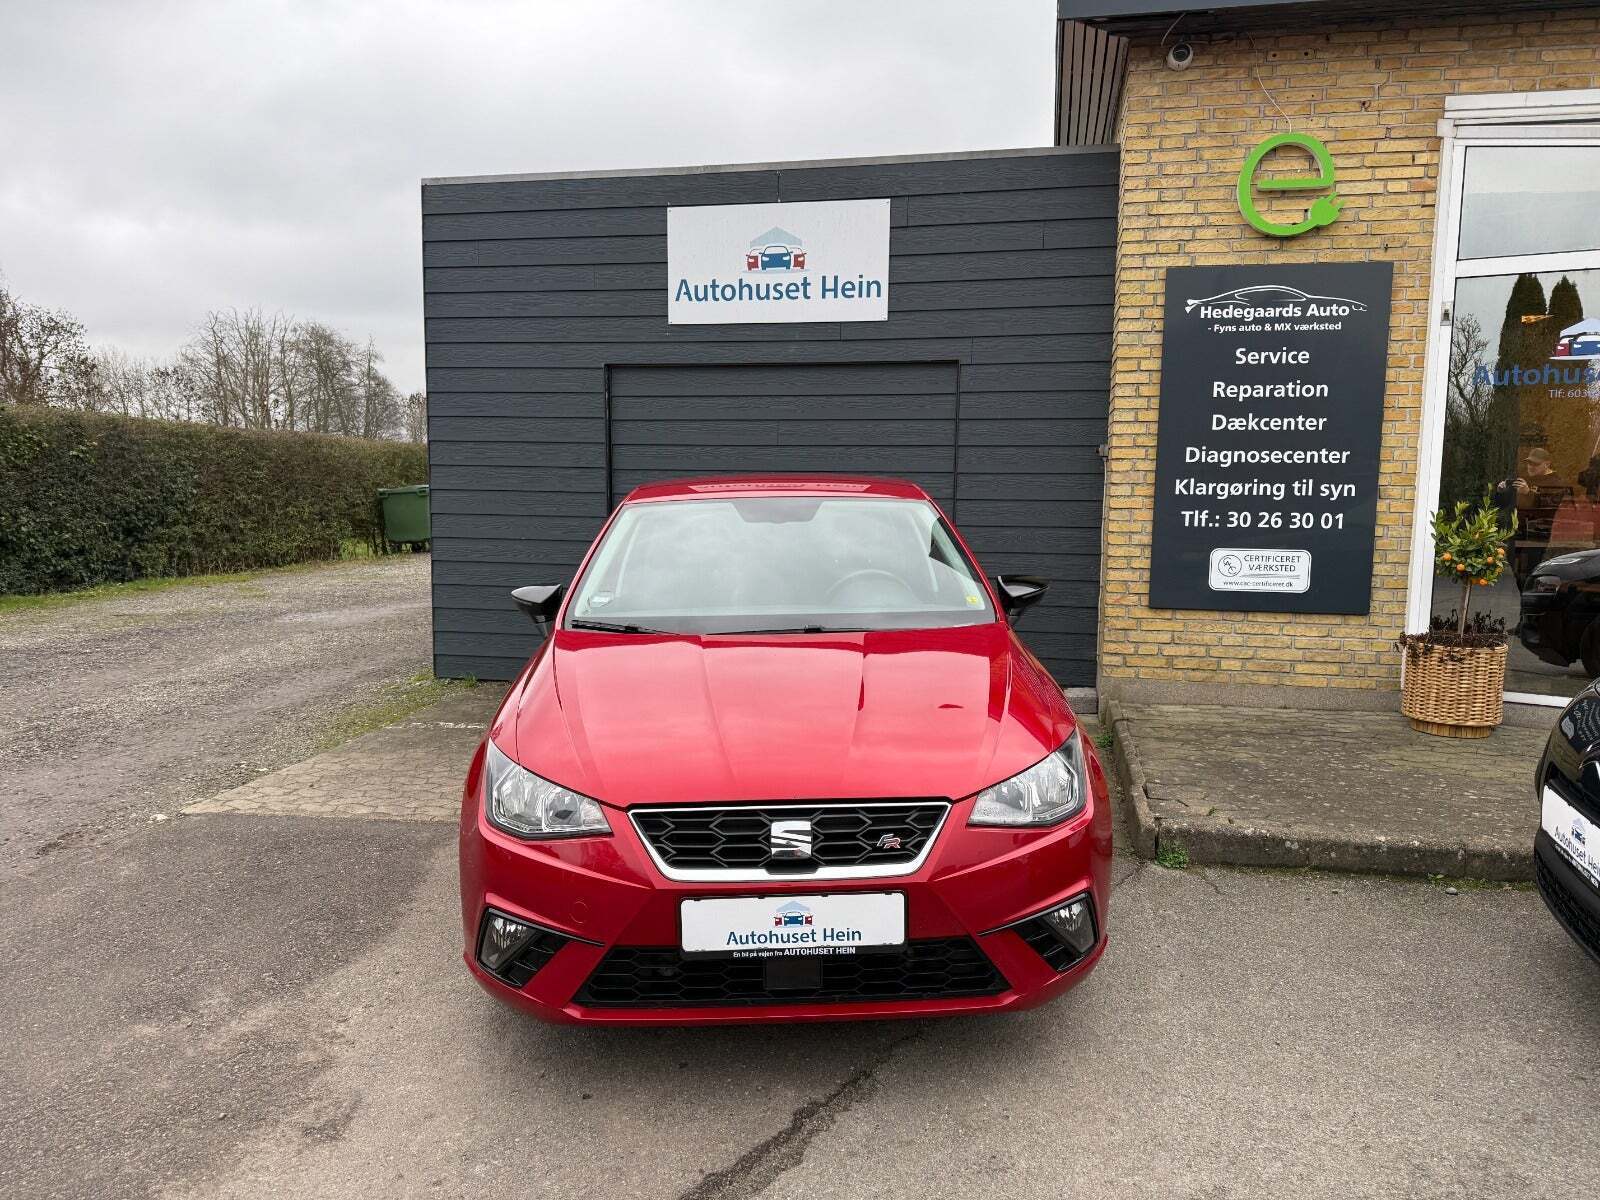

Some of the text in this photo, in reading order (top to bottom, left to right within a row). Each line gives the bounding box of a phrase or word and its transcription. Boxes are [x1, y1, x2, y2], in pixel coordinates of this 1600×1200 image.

[675, 274, 882, 302] Autohuset Hein
[1200, 303, 1350, 321] Hedegaards Auto
[1214, 324, 1237, 334] Fyns
[1239, 323, 1262, 332] auto
[1264, 323, 1272, 332] &
[1275, 322, 1292, 332] MX
[1293, 322, 1342, 331] værksted
[1235, 347, 1310, 364] Service
[1472, 363, 1600, 385] Autohus
[1213, 380, 1329, 401] Reparation
[1211, 413, 1327, 431] Dækcenter
[1185, 446, 1351, 468] Diagnosecenter
[1175, 478, 1356, 500] Klargøring til syn
[1181, 510, 1344, 530] Tlf.: 30 26 30 01
[1243, 554, 1301, 563] CERTIFICERET
[1249, 564, 1296, 572] VÆRKSTED
[726, 928, 862, 946] Autohuset Hein
[783, 947, 834, 956] AUTOHUSET
[835, 947, 856, 955] HEIN
